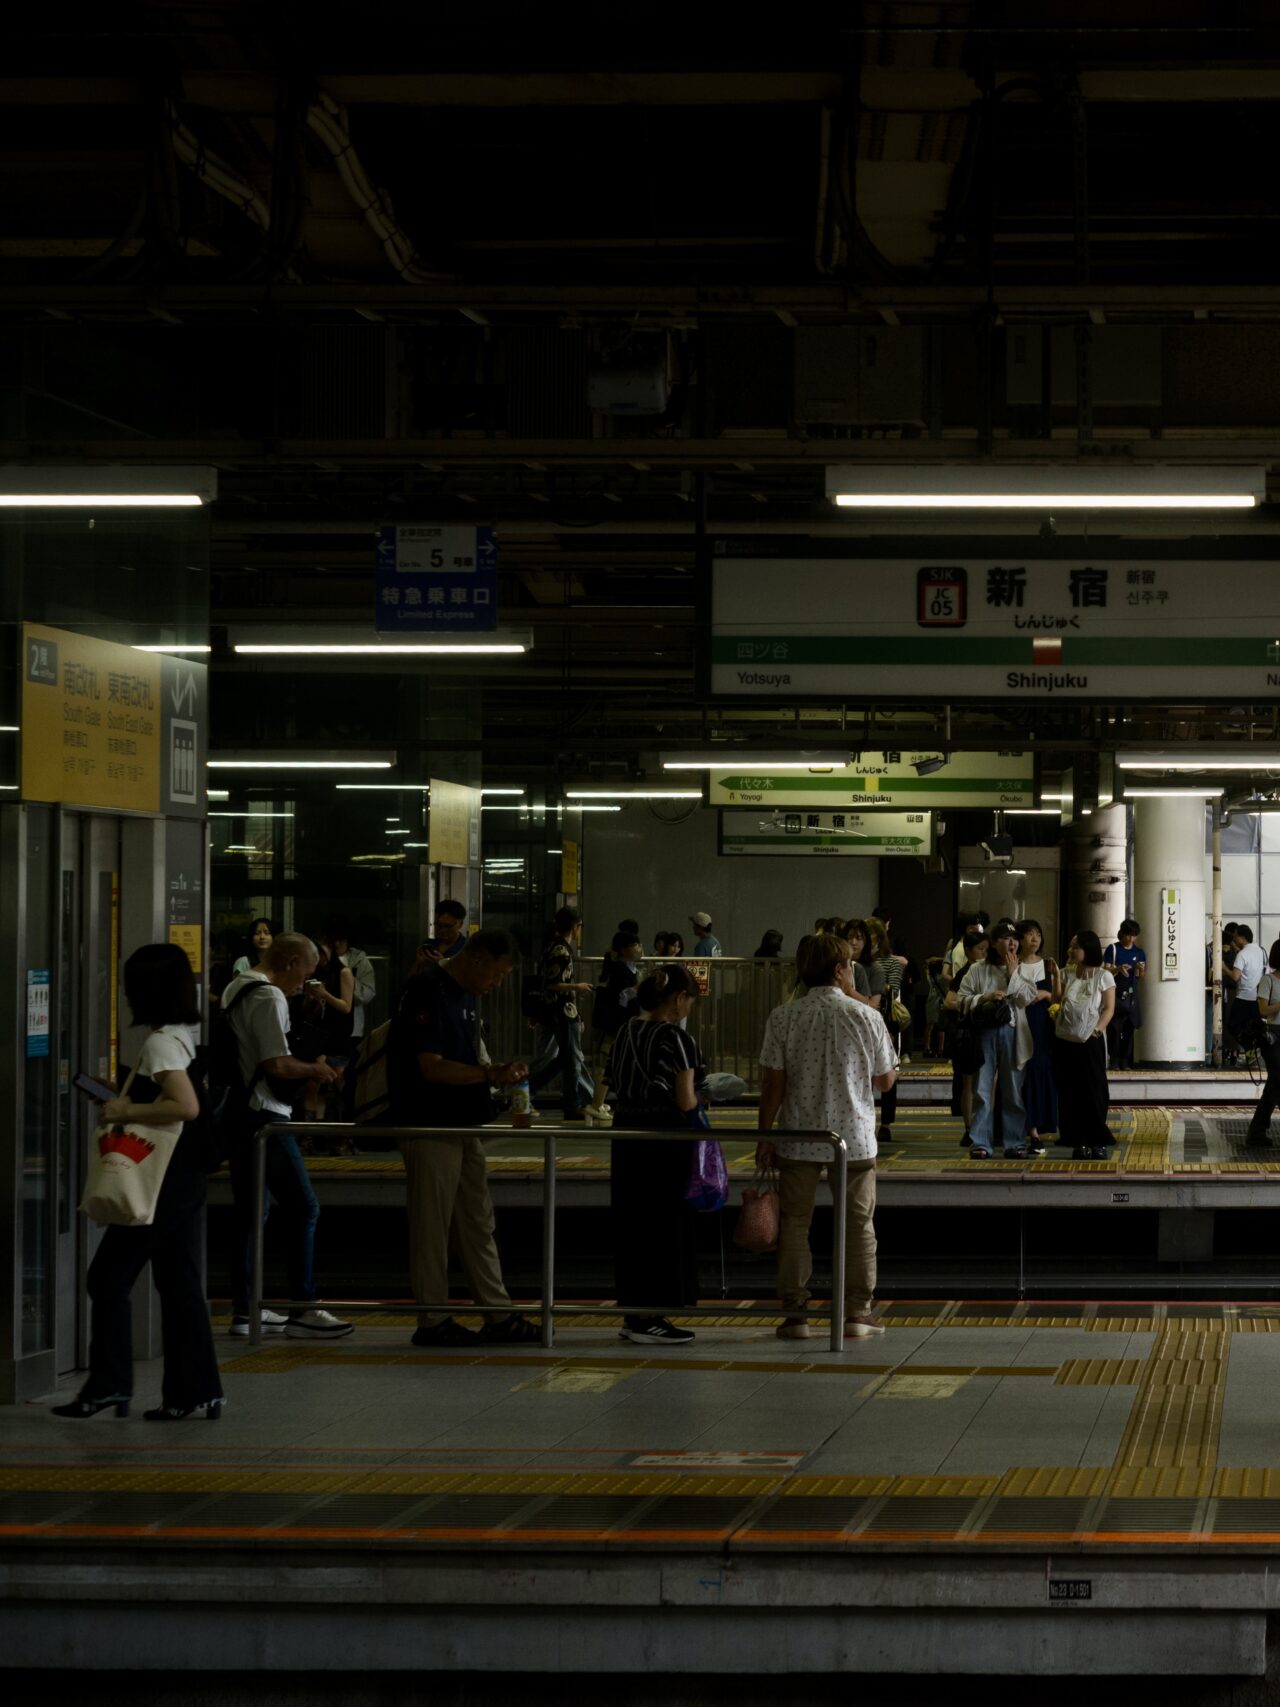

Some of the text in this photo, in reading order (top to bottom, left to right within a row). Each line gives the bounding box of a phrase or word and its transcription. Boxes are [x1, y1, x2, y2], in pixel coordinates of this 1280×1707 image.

[431, 549, 443, 567] 5
[929, 569, 954, 581] SJK
[935, 588, 950, 600] JC
[986, 567, 1109, 607] 新宿
[381, 586, 491, 606] 特急乗車口
[1126, 590, 1169, 606] 신주쿠
[397, 609, 475, 621] Limited Express
[931, 600, 954, 616] 05
[1014, 614, 1081, 629] しんじゅく
[736, 642, 790, 660] 四ツ谷
[737, 671, 792, 687] Yotsuya
[1007, 672, 1088, 693] Shinjuku
[739, 778, 774, 789] 代々木
[740, 793, 763, 802] Yoyogi
[852, 795, 892, 805] Shinjuku
[1167, 906, 1176, 951] しんじゅく
